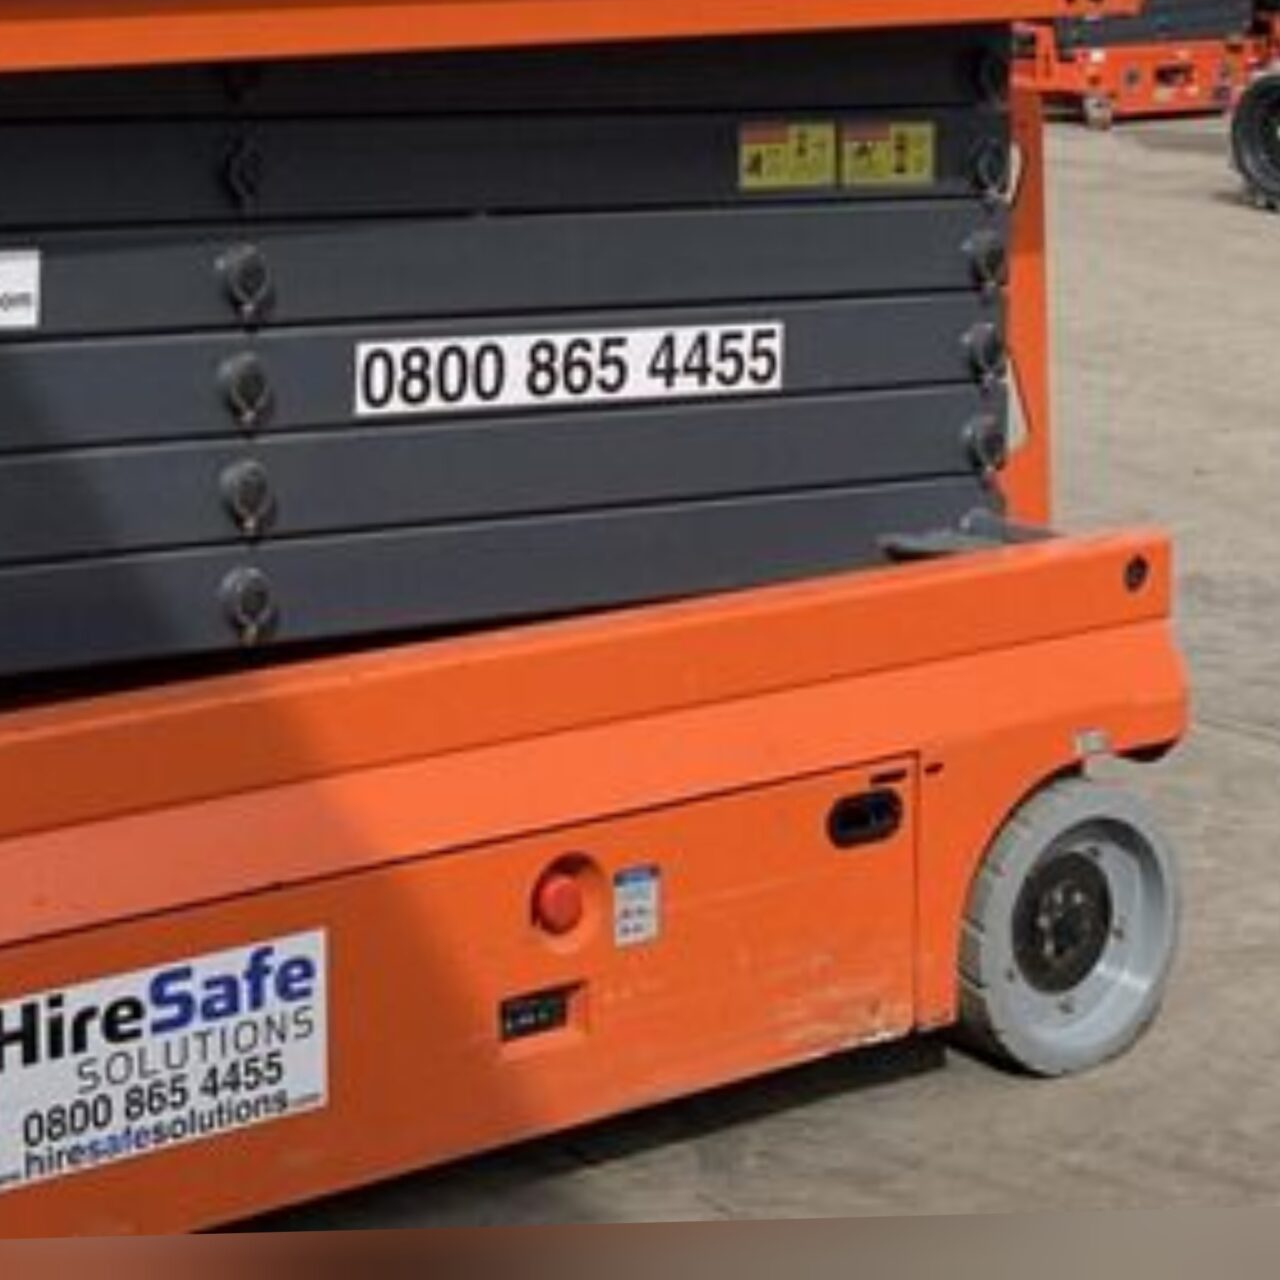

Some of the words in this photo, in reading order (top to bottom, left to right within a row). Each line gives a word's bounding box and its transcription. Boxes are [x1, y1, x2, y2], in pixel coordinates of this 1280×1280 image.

[362, 343, 505, 408] 0800
[526, 337, 628, 396] 865
[647, 328, 777, 388] 4455
[77, 1006, 315, 1095] SOLUTIONS
[23, 1093, 113, 1148] 0800
[124, 1075, 189, 1121] 865
[199, 1051, 283, 1100] 4455
